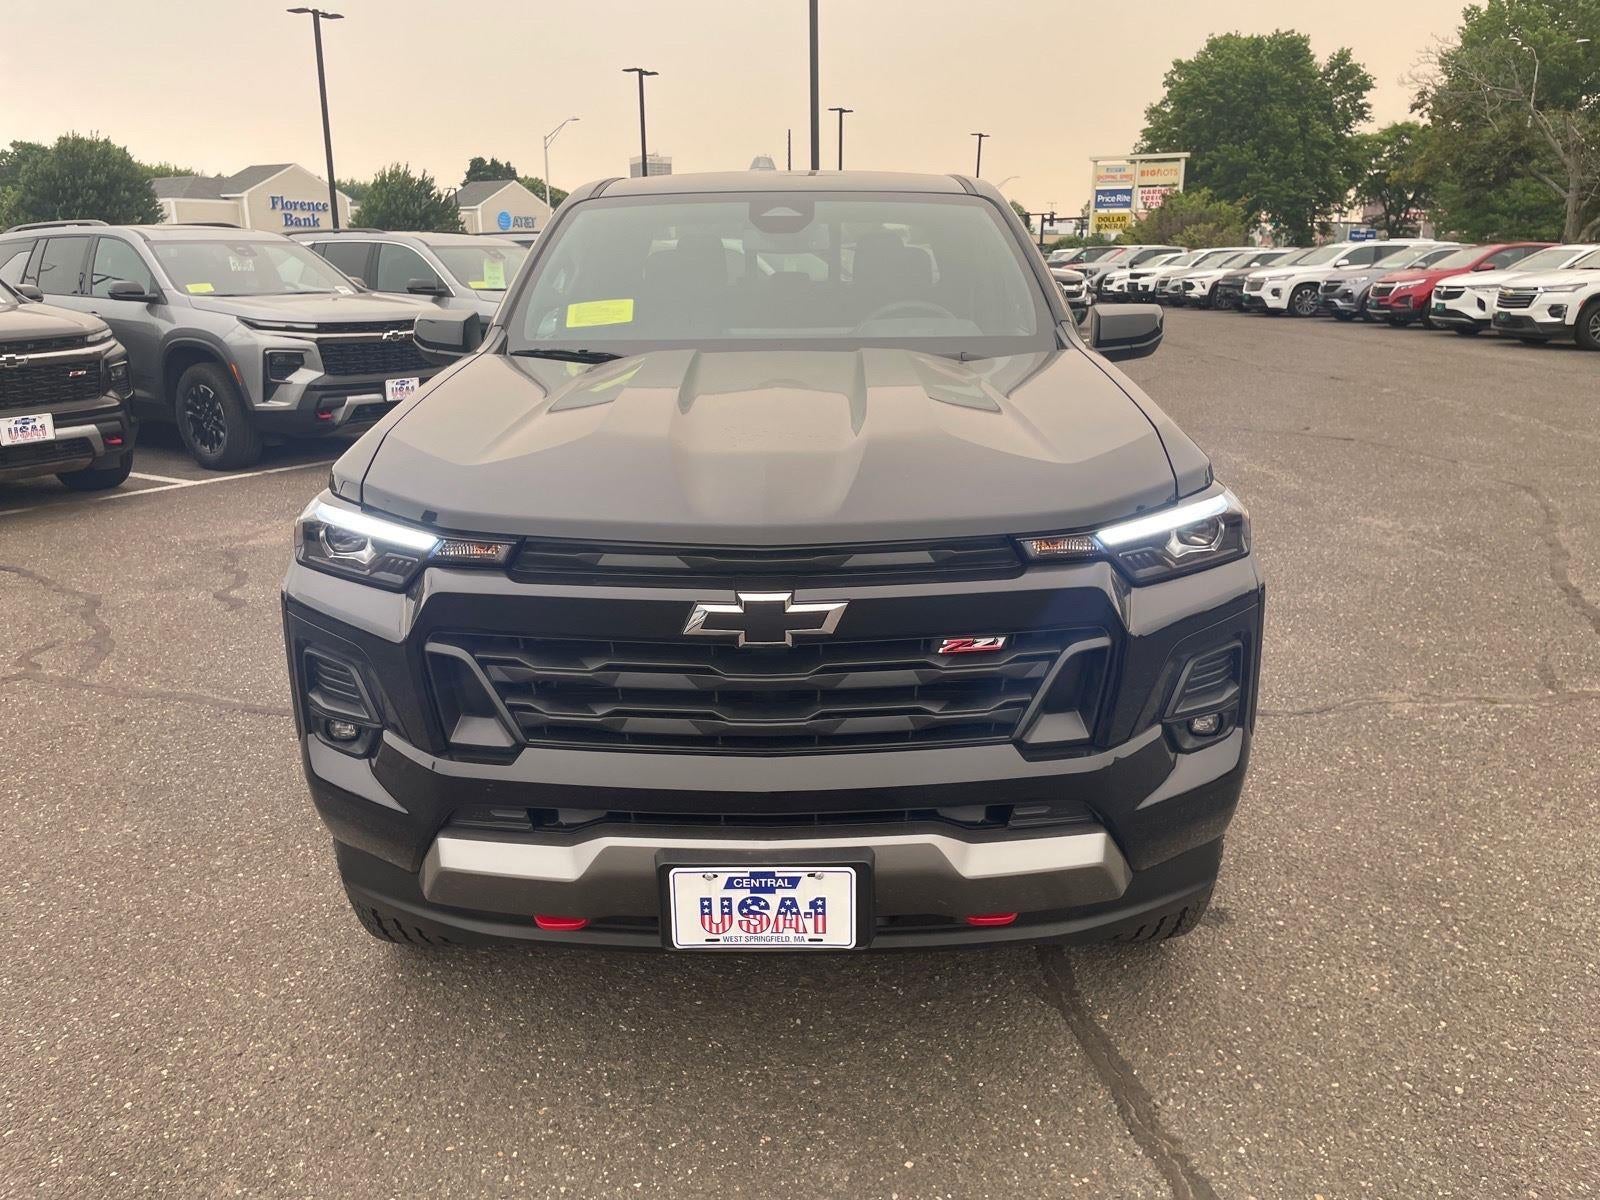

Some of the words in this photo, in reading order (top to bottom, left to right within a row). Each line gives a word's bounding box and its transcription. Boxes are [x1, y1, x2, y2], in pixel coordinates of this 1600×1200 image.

[270, 196, 329, 212] Florence
[283, 213, 320, 227] Bank
[512, 216, 536, 229] AT&T
[733, 878, 792, 888] CENTRAL
[700, 896, 827, 935] USA-1
[722, 935, 743, 943] WEST
[794, 935, 806, 943] MA
